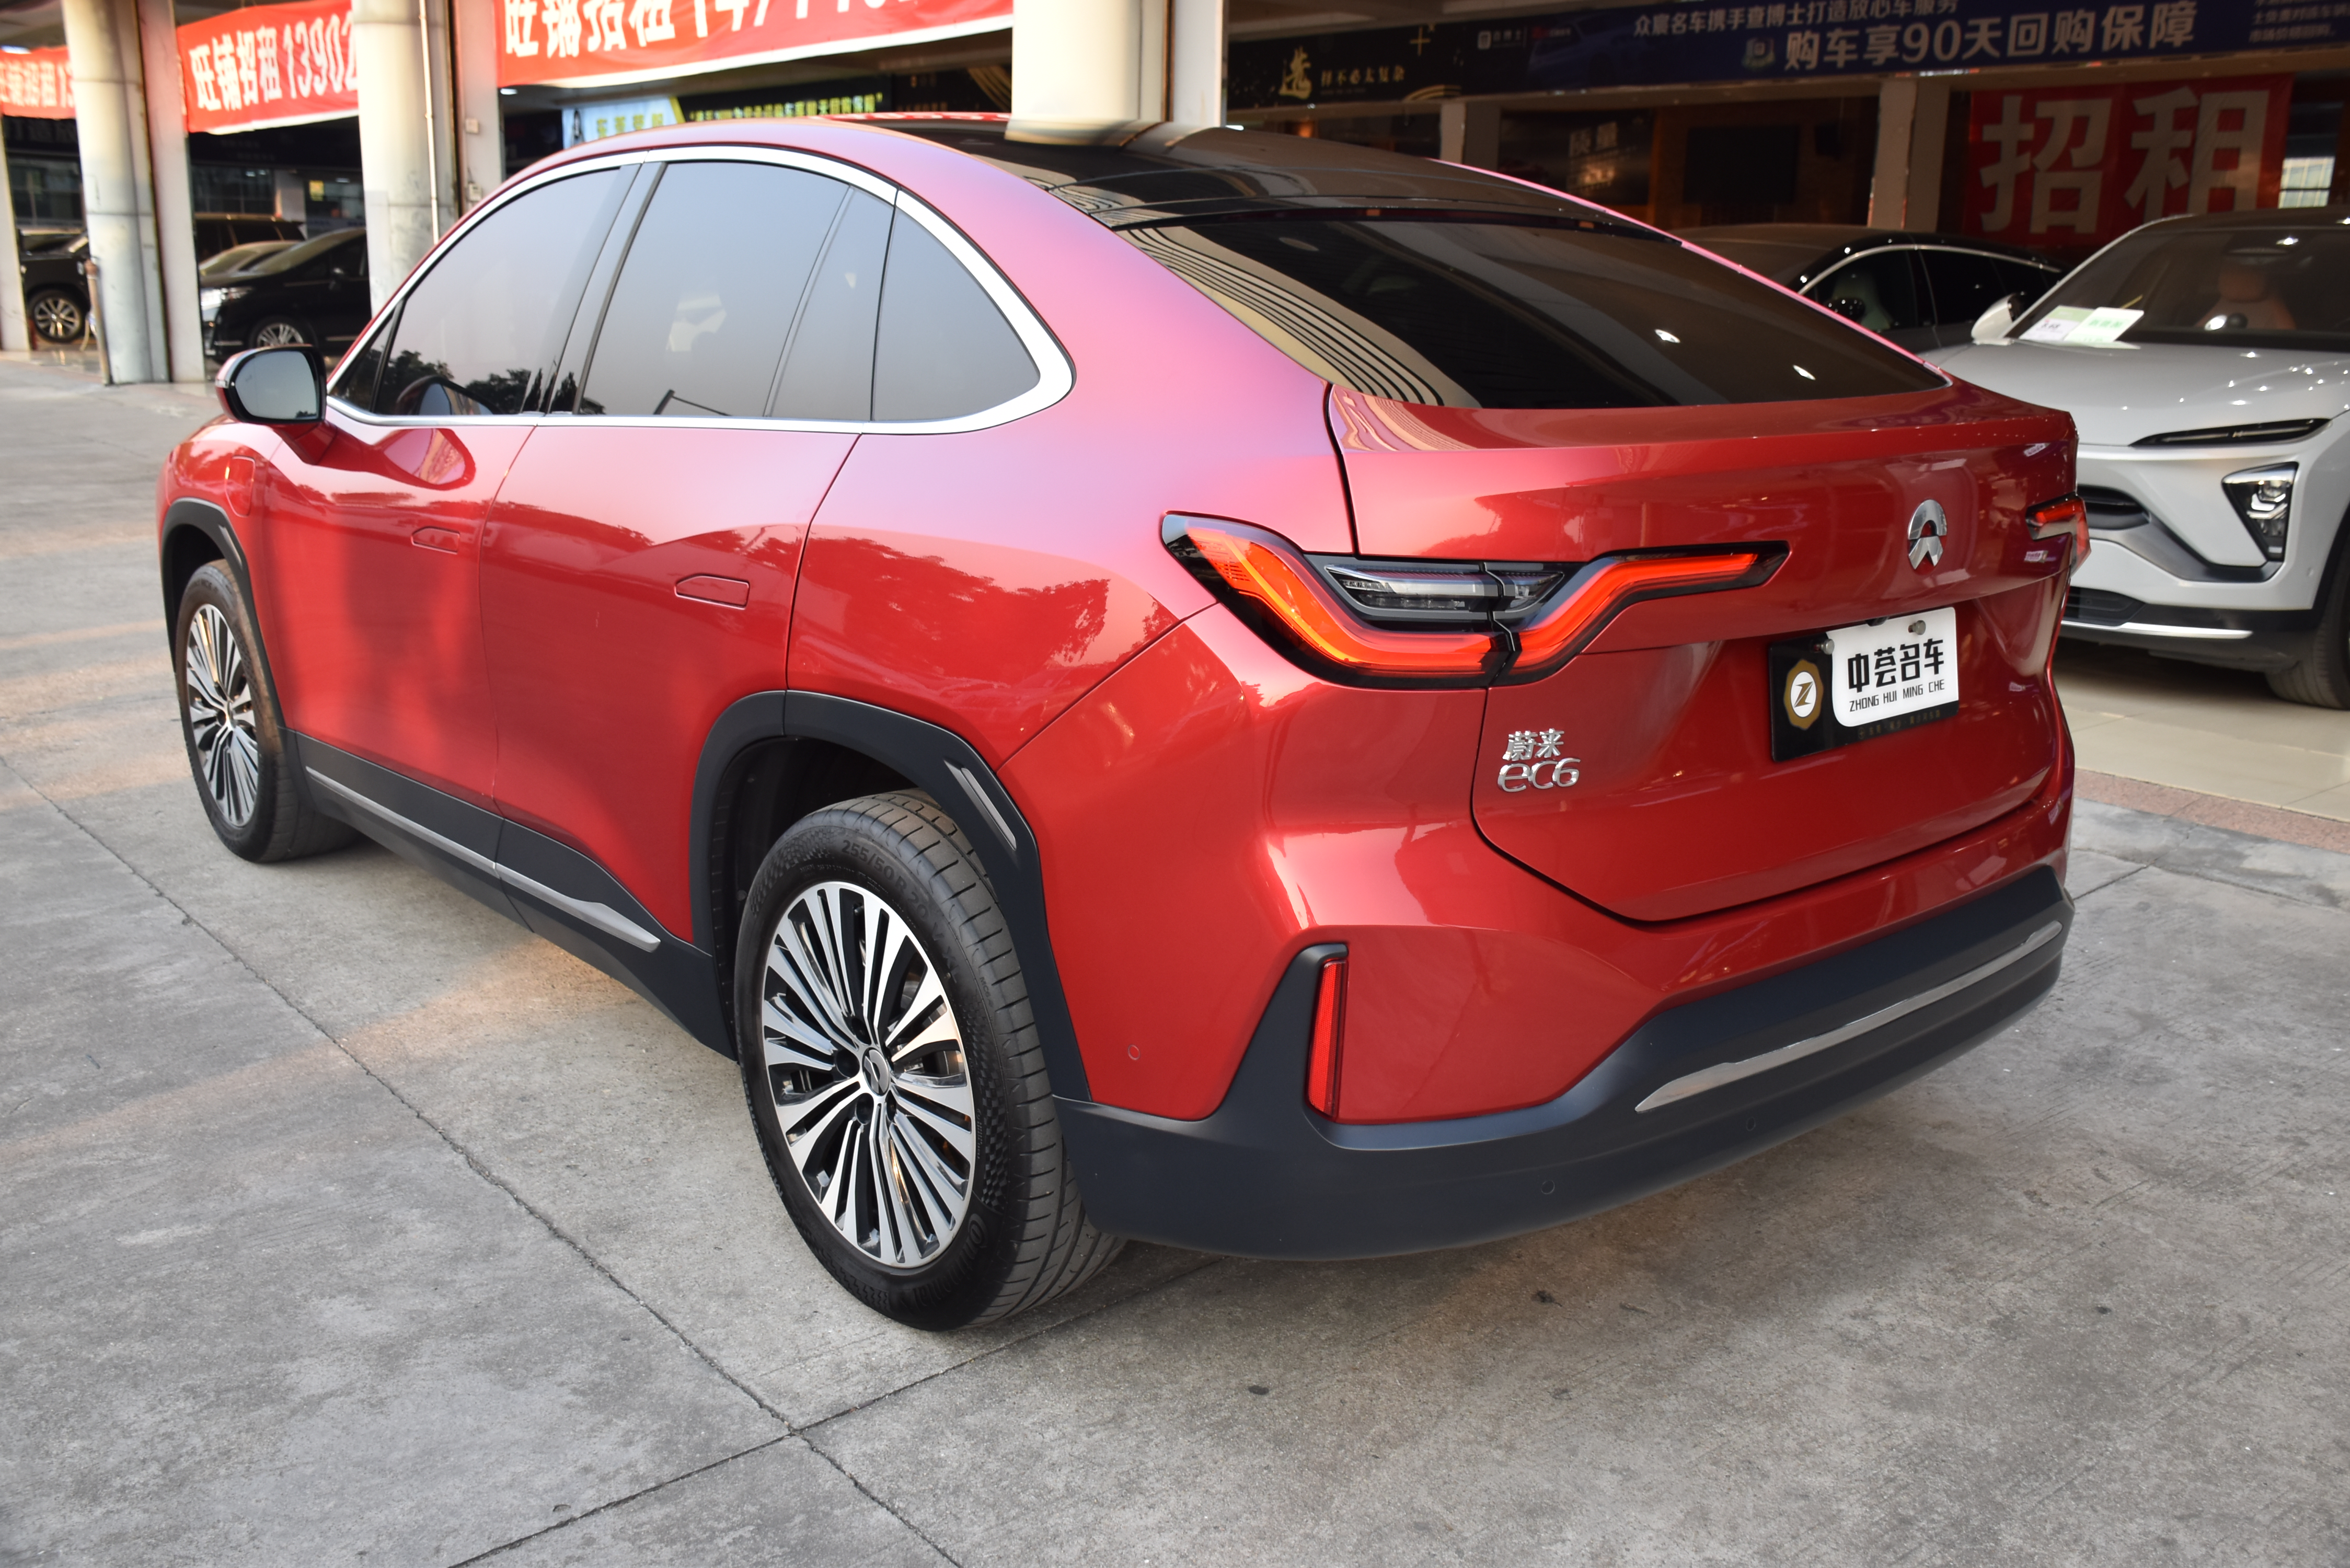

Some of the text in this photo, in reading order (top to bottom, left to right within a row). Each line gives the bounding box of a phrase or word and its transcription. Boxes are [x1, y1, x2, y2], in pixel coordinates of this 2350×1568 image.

[1784, 2, 2196, 71] 购车享90天回购保障
[1979, 86, 2270, 234] 招租
[1848, 638, 1944, 693] 中荟名车
[1849, 679, 1945, 712] ZHONG HUI MING CHE
[1503, 728, 1564, 761] 蔚来
[842, 840, 895, 880] 255/50
